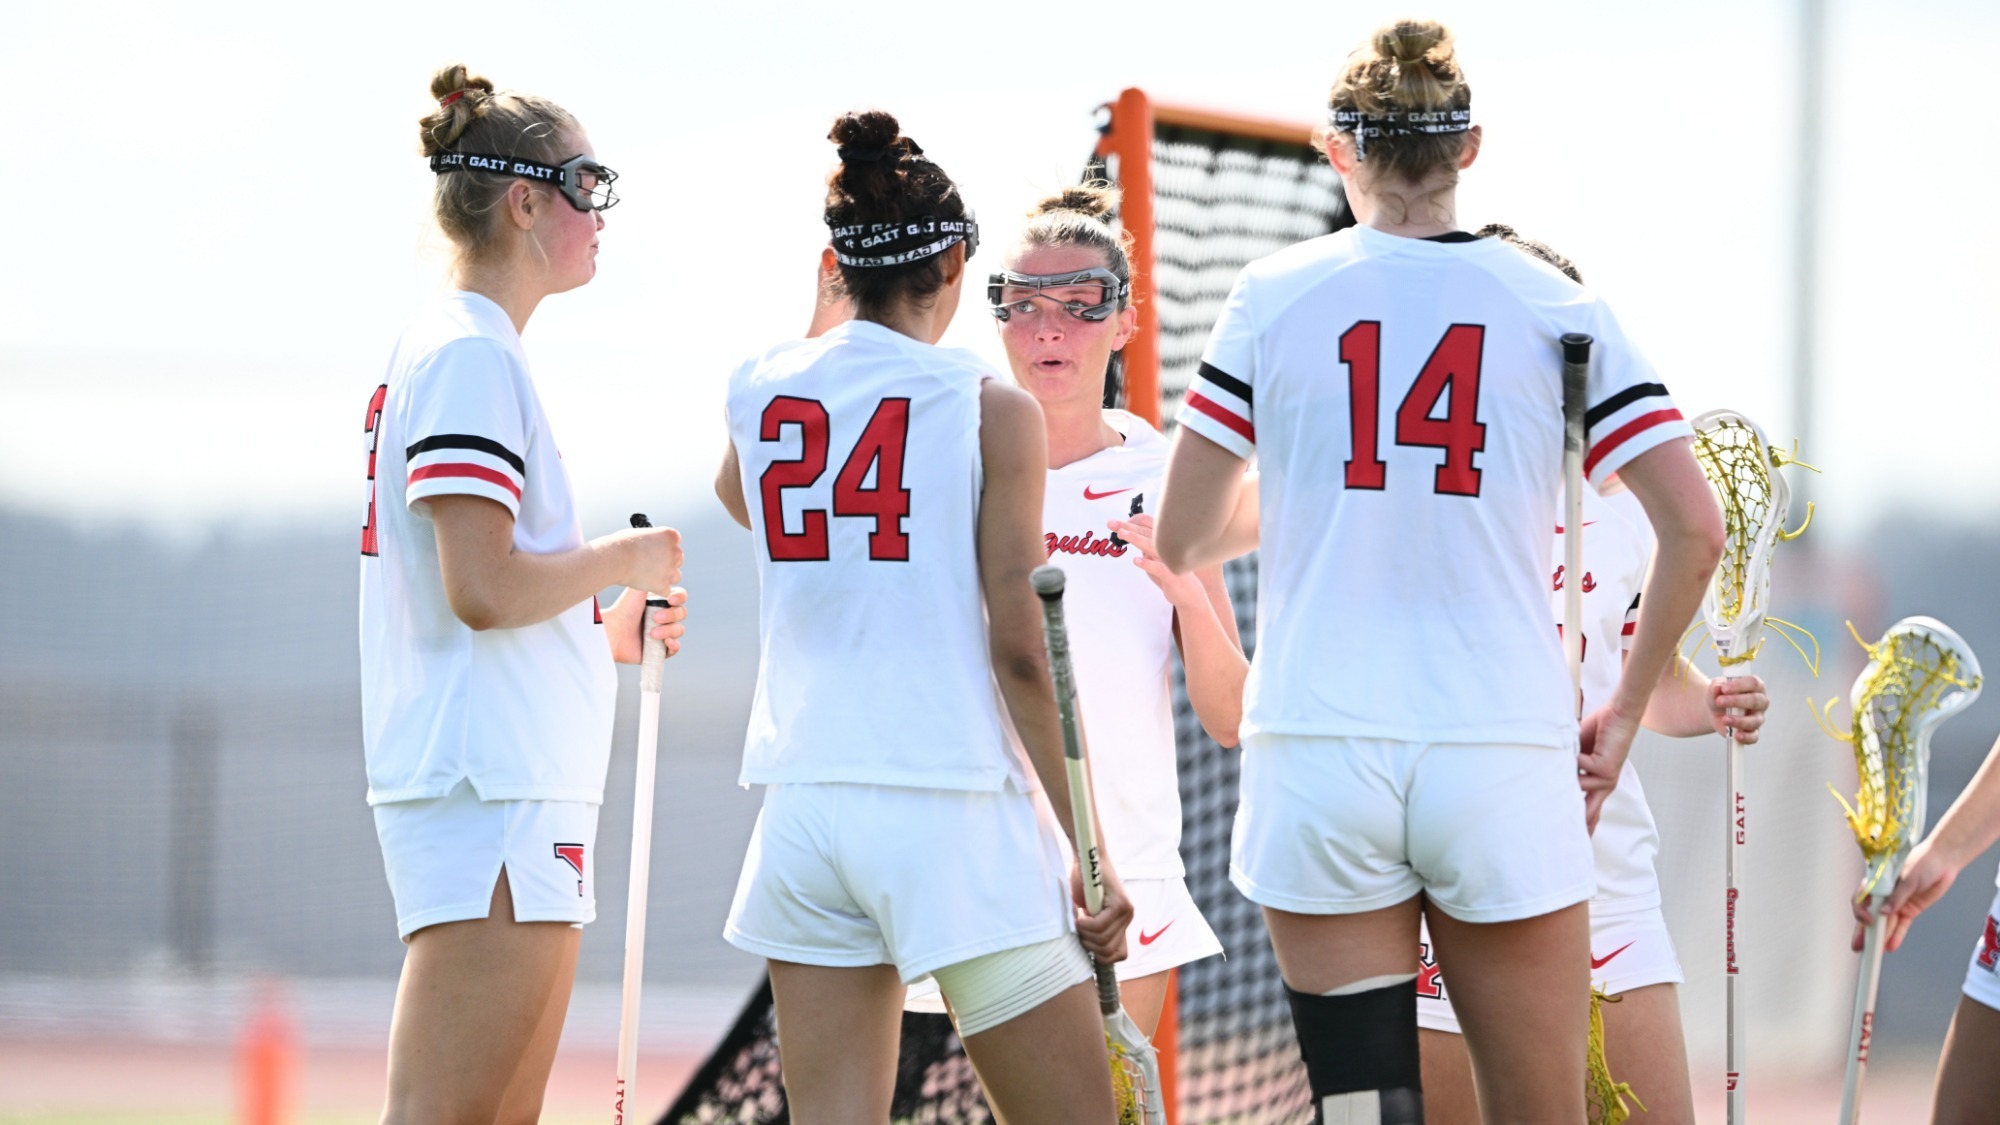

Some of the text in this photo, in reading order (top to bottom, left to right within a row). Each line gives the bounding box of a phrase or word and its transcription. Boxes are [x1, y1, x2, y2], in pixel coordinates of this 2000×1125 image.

[1337, 111, 1362, 122] GAIT
[1408, 111, 1446, 122] GAIT
[440, 154, 465, 165] GAIT
[469, 156, 507, 171] GAIT
[513, 163, 554, 179] GAIT
[834, 224, 864, 239] GAIT
[860, 228, 900, 248] GAIT
[940, 222, 964, 233] GAIT
[1338, 319, 1487, 498] 14
[759, 394, 912, 562] 24
[1736, 792, 1745, 844] GAIT
[1087, 846, 1102, 888] GAIT
[1857, 1012, 1874, 1063] GAIT
[614, 1076, 625, 1125] GAIT
